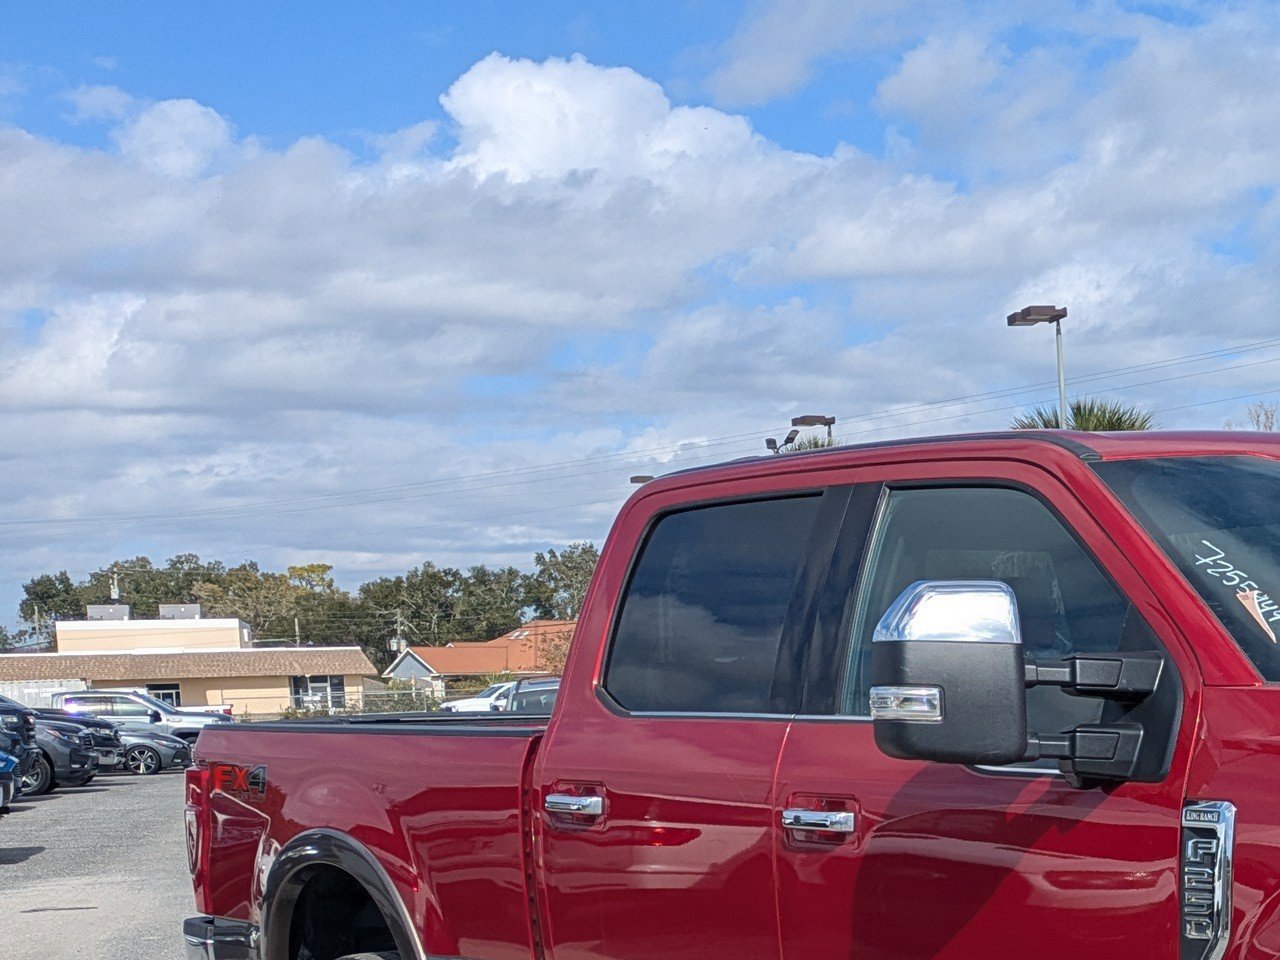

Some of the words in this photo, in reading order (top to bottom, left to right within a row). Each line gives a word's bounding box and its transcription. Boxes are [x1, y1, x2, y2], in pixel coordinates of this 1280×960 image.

[213, 765, 267, 794] FX4
[1186, 810, 1200, 820] KING
[1200, 812, 1219, 821] RANCH
